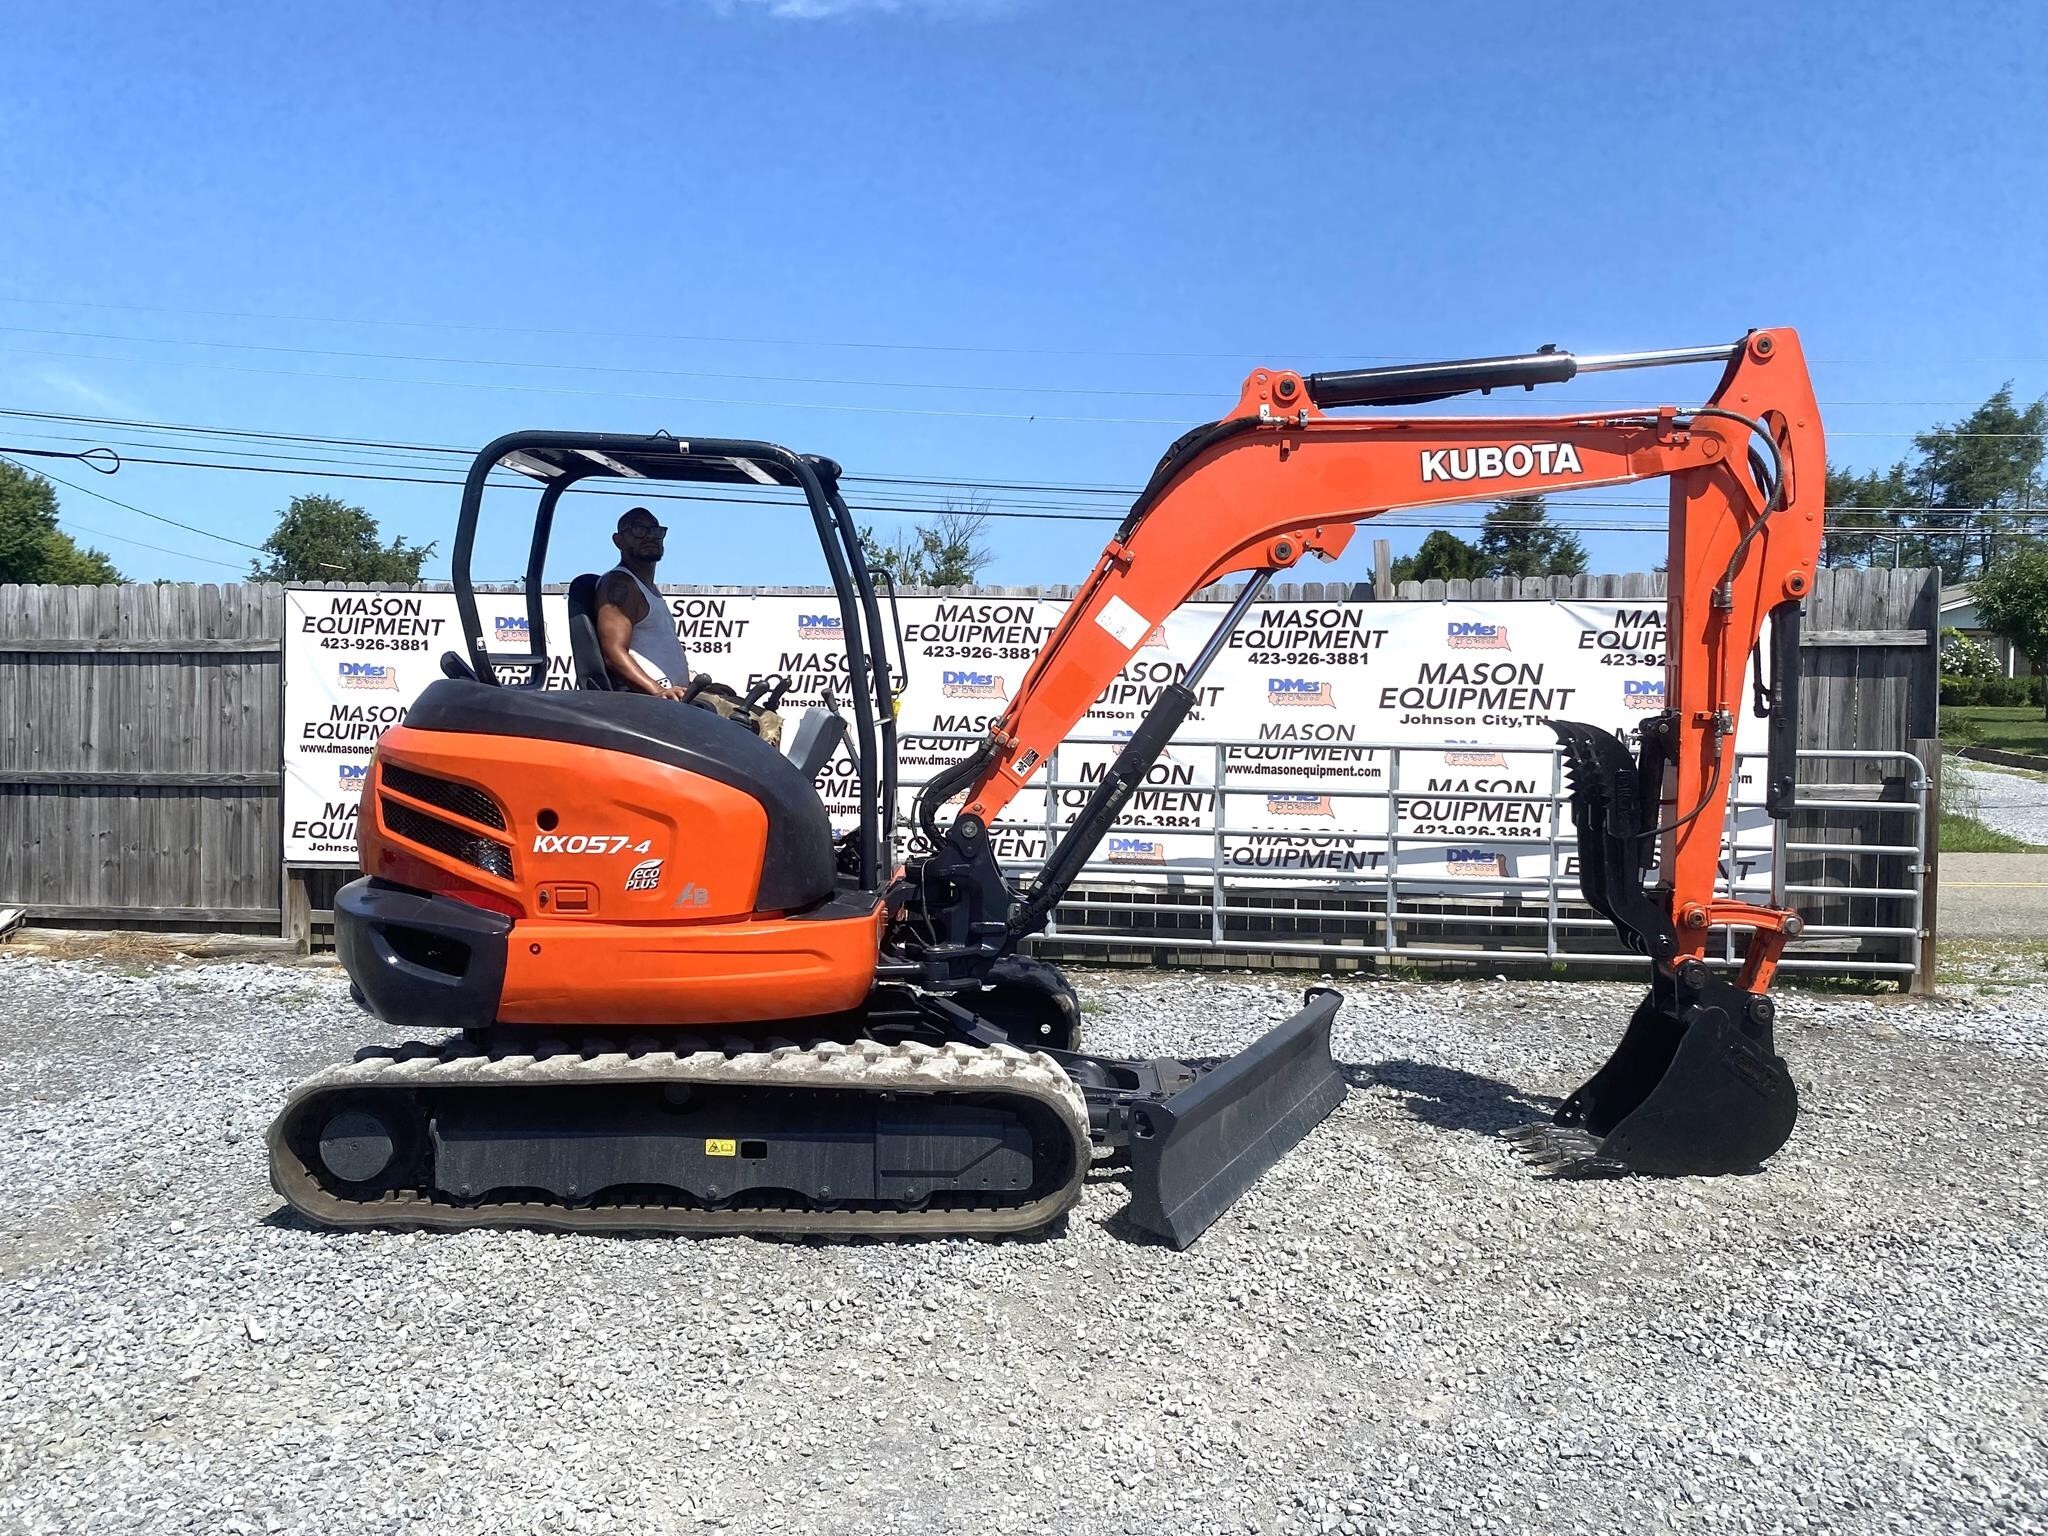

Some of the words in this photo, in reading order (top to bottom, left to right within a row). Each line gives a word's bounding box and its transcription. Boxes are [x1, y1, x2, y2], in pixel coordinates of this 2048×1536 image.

[1420, 442, 1583, 482] KUBOTA
[330, 597, 422, 617] MASON
[672, 599, 726, 618] SON
[934, 604, 1034, 624] MASON
[302, 616, 446, 636] EQUIPMENT
[1260, 609, 1364, 629] MASON
[320, 637, 430, 651] 423-926-3881
[904, 624, 1057, 644] EQUIPMENT
[1228, 630, 1389, 650] EQUIPMENT
[1578, 630, 1667, 651] EQUIP
[923, 645, 1039, 660] 423-926-3881
[1248, 652, 1369, 665] 423-926-3881
[1600, 653, 1667, 667] 423-92
[1115, 661, 1192, 683] ASON
[1417, 662, 1544, 686] MASON
[1379, 687, 1576, 711] EQUIPMENT
[1400, 713, 1476, 725] Johnson
[303, 722, 390, 740] EQUIPM
[1258, 723, 1356, 742] MASON
[1080, 762, 1195, 785] MON
[1225, 763, 1382, 779] www.dmasonequipment.com
[308, 842, 359, 853] Johnso
[532, 835, 652, 855] KX057-4
[624, 877, 659, 891] PLUS
